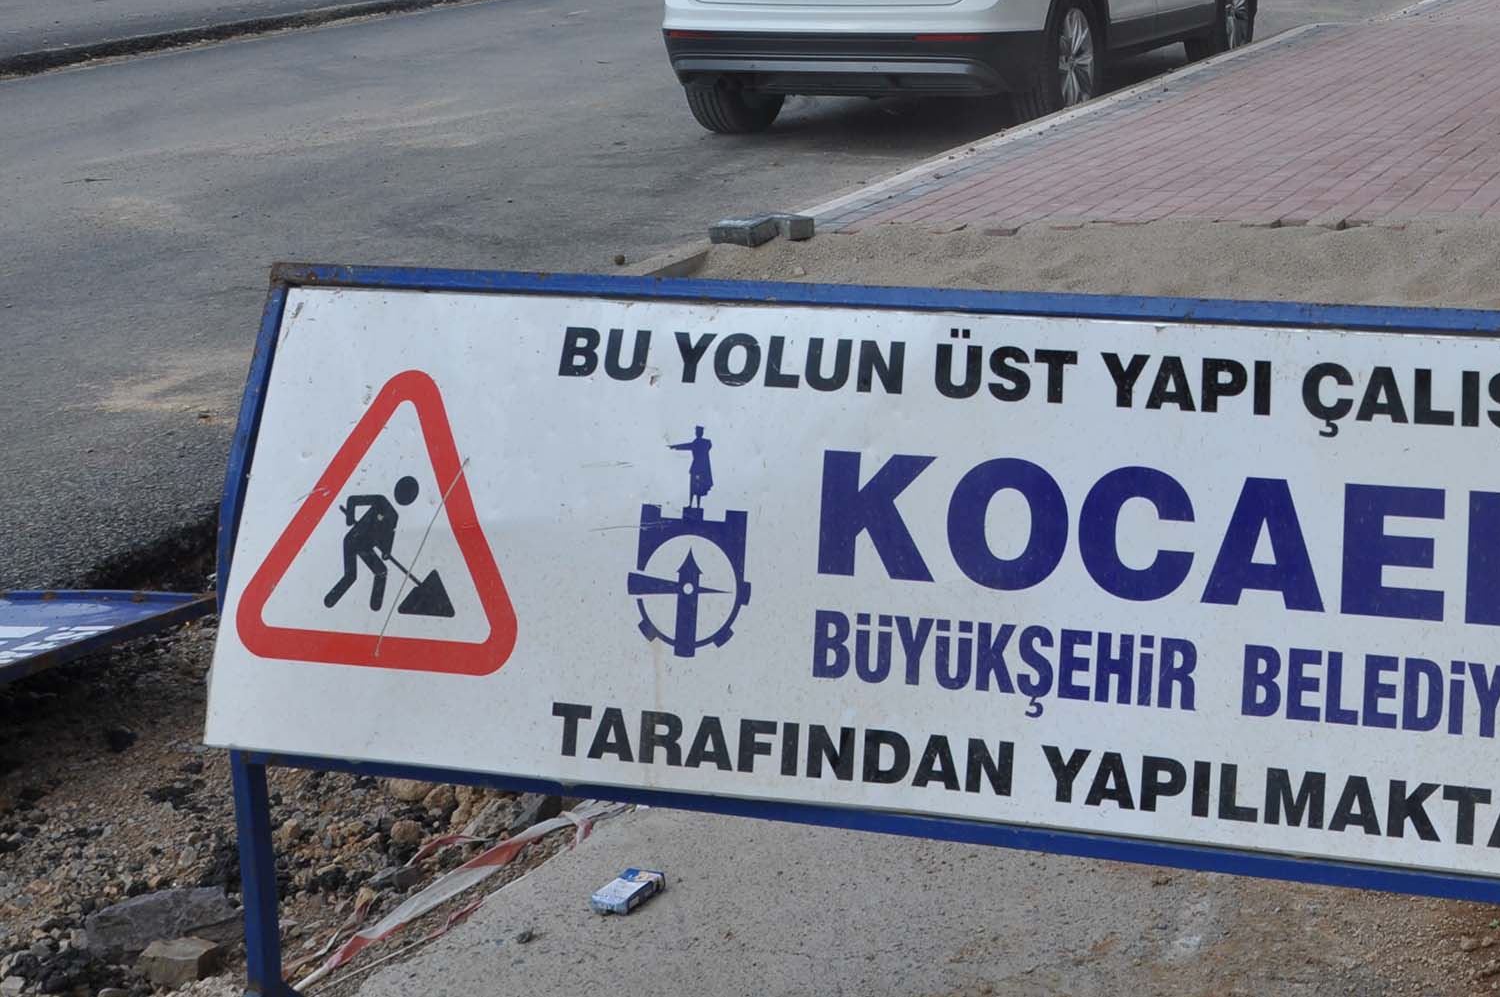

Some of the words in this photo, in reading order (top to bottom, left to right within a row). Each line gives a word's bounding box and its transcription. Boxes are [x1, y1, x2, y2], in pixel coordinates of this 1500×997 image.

[558, 326, 652, 381] BU
[674, 331, 906, 395] YOLUN
[934, 328, 1078, 404] ÜST
[1100, 352, 1272, 416] YAPI
[812, 609, 1198, 718] BÜYÜKŞEHİR
[551, 701, 1015, 797] TARAFINDAN
